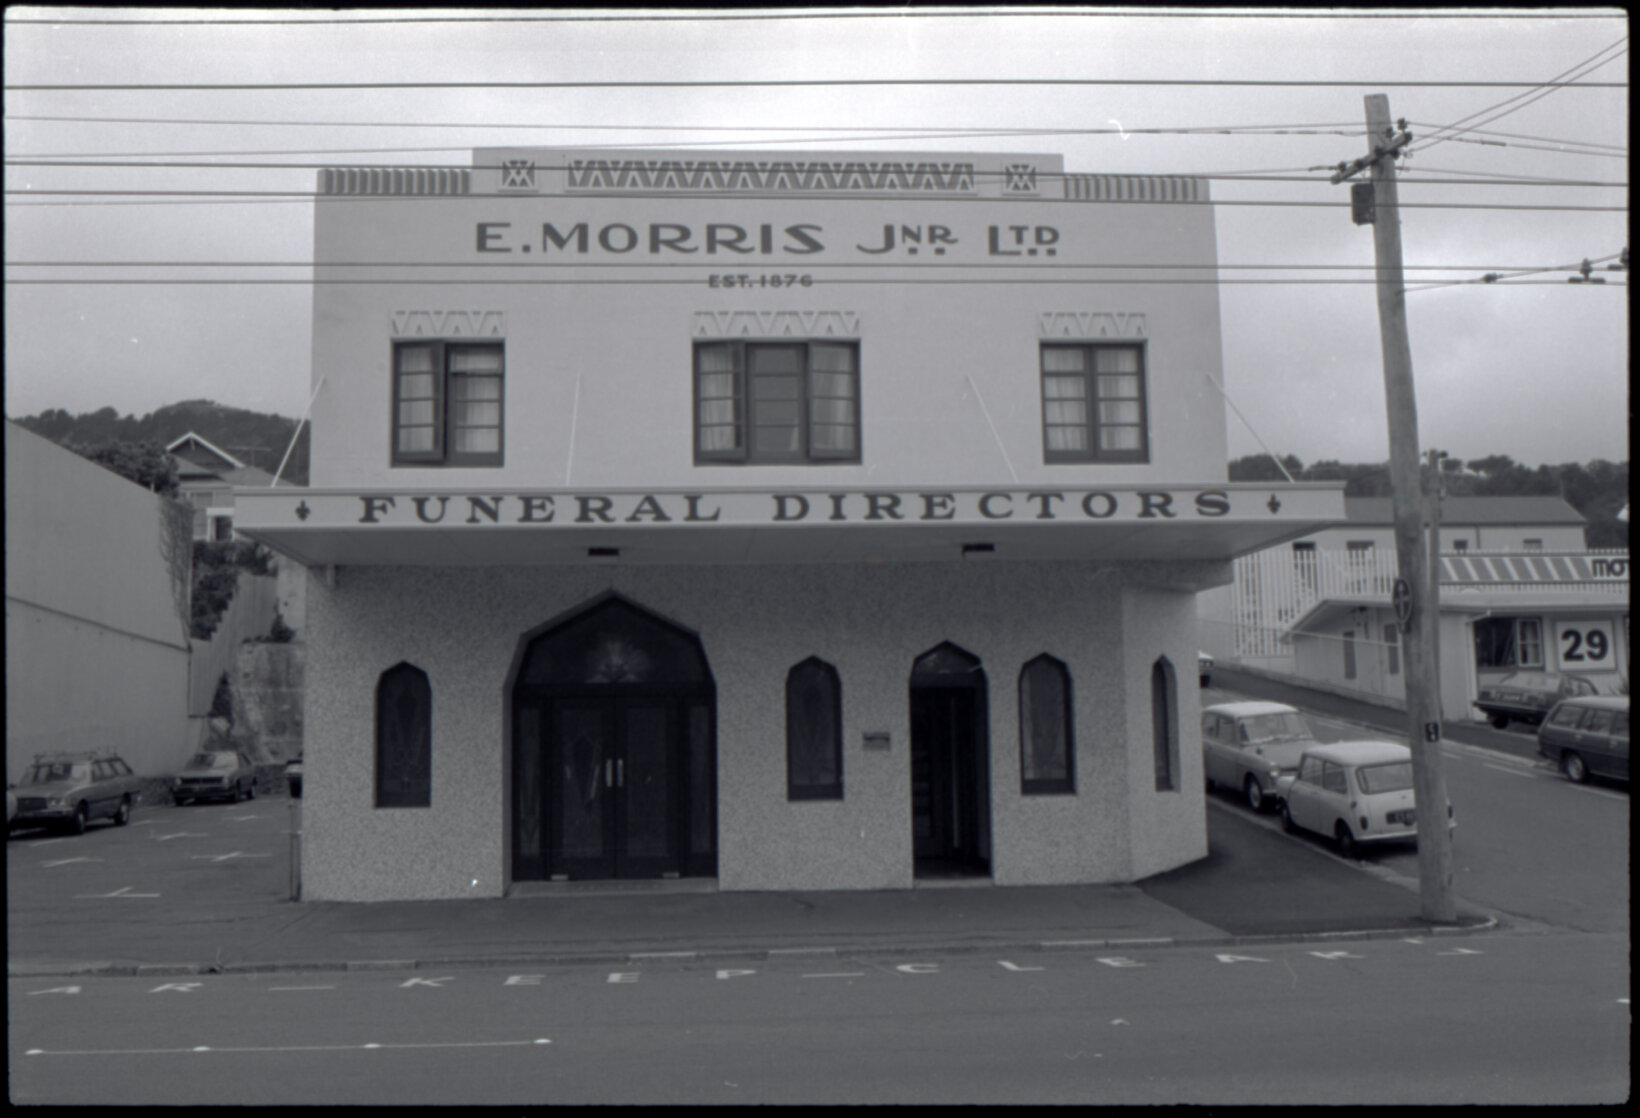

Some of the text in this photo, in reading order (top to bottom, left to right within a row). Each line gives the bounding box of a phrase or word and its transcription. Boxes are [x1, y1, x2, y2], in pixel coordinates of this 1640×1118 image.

[760, 274, 813, 288] 1876
[359, 491, 1230, 523] FUNERAL DIRECTORS
[1561, 628, 1609, 662] 29
